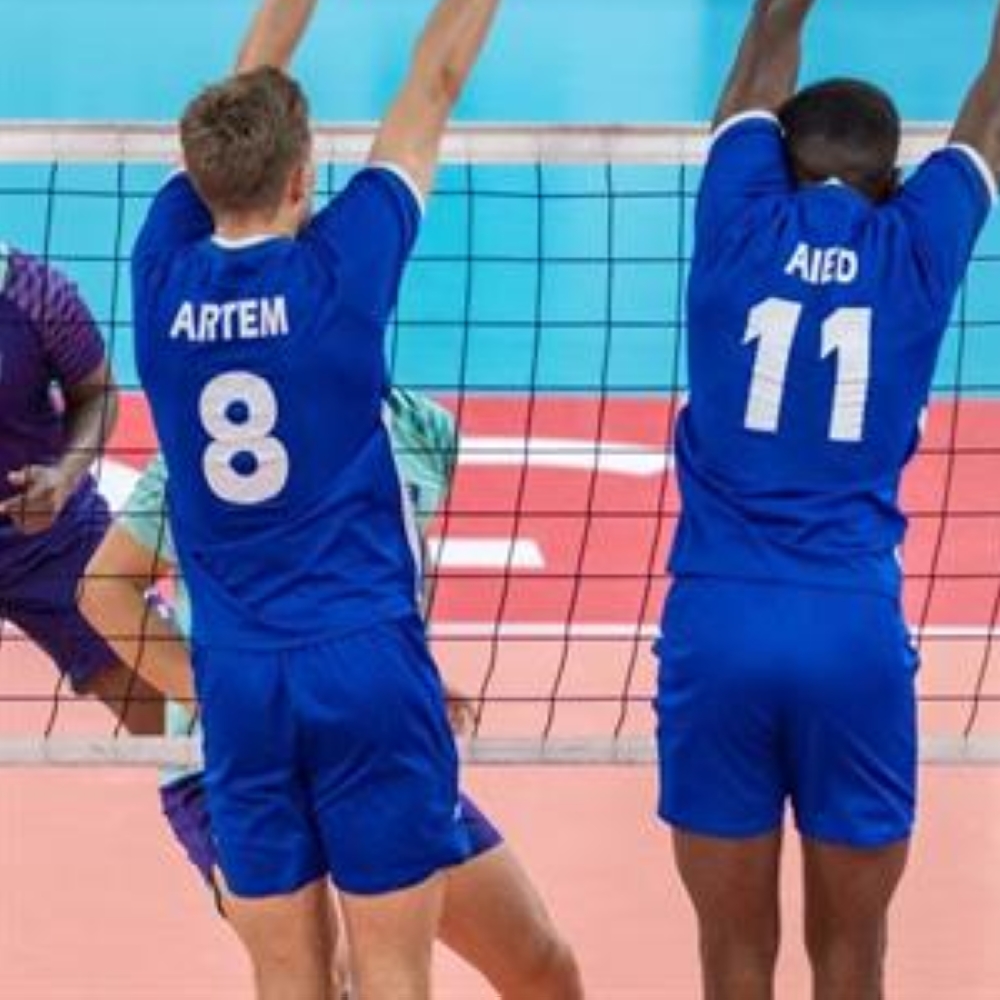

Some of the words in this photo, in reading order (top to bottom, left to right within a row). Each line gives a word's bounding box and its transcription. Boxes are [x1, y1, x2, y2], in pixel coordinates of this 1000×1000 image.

[784, 241, 860, 286] AIED
[169, 294, 290, 342] ARTEM
[741, 296, 873, 443] 11
[198, 369, 290, 505] 8
